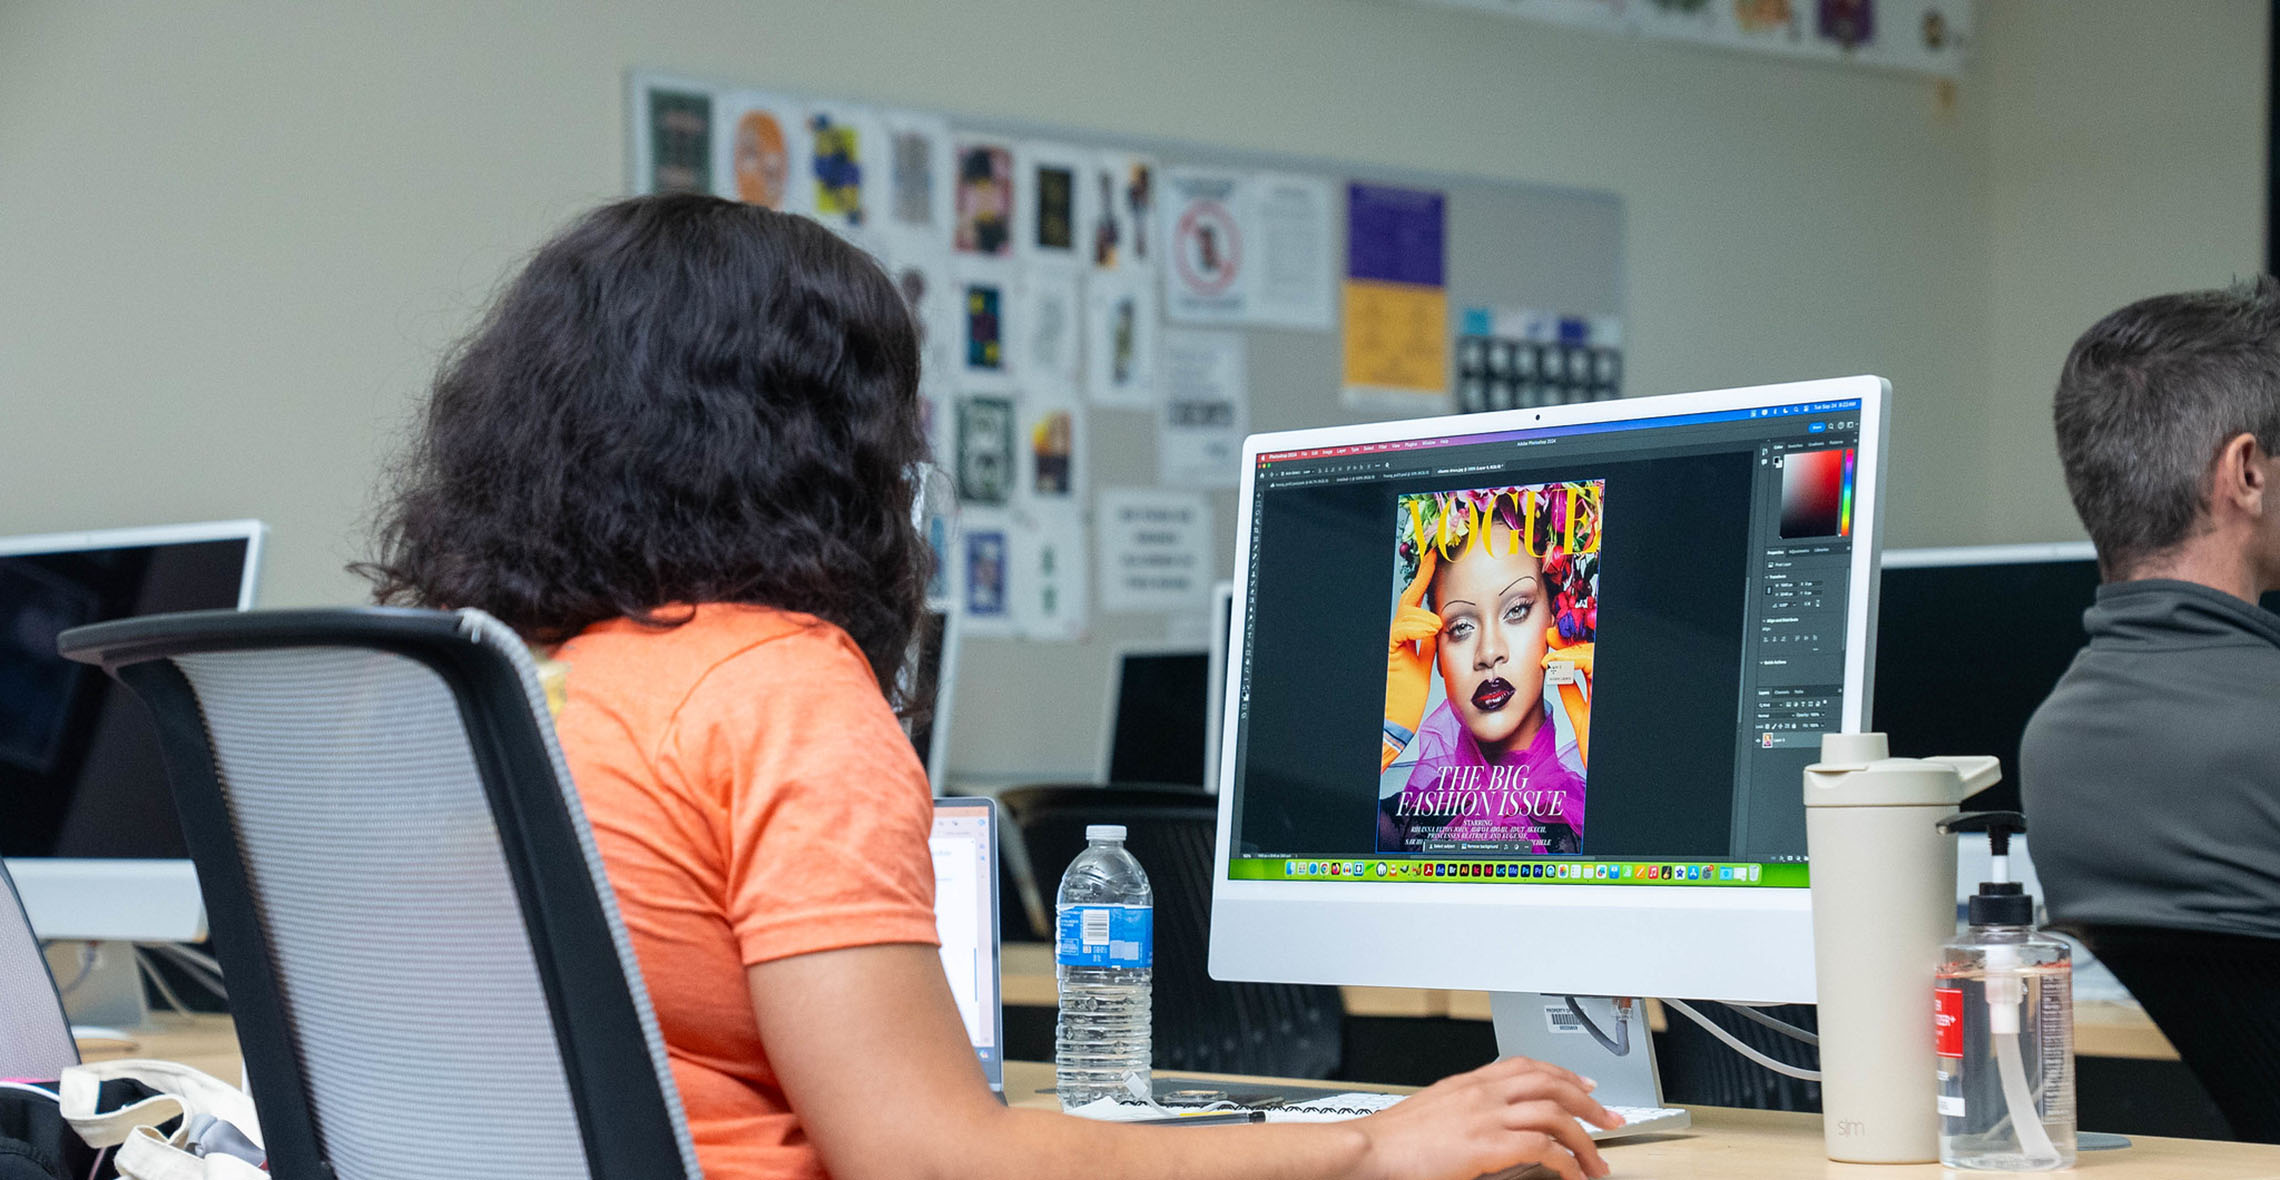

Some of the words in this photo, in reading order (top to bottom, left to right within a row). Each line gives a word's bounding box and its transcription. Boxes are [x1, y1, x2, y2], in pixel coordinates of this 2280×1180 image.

[1408, 486, 1600, 563] VOGUE
[1436, 765, 1485, 791] THE
[1487, 764, 1530, 791] BIG
[1396, 790, 1497, 817] FASHION
[1498, 789, 1567, 817] ISSUE
